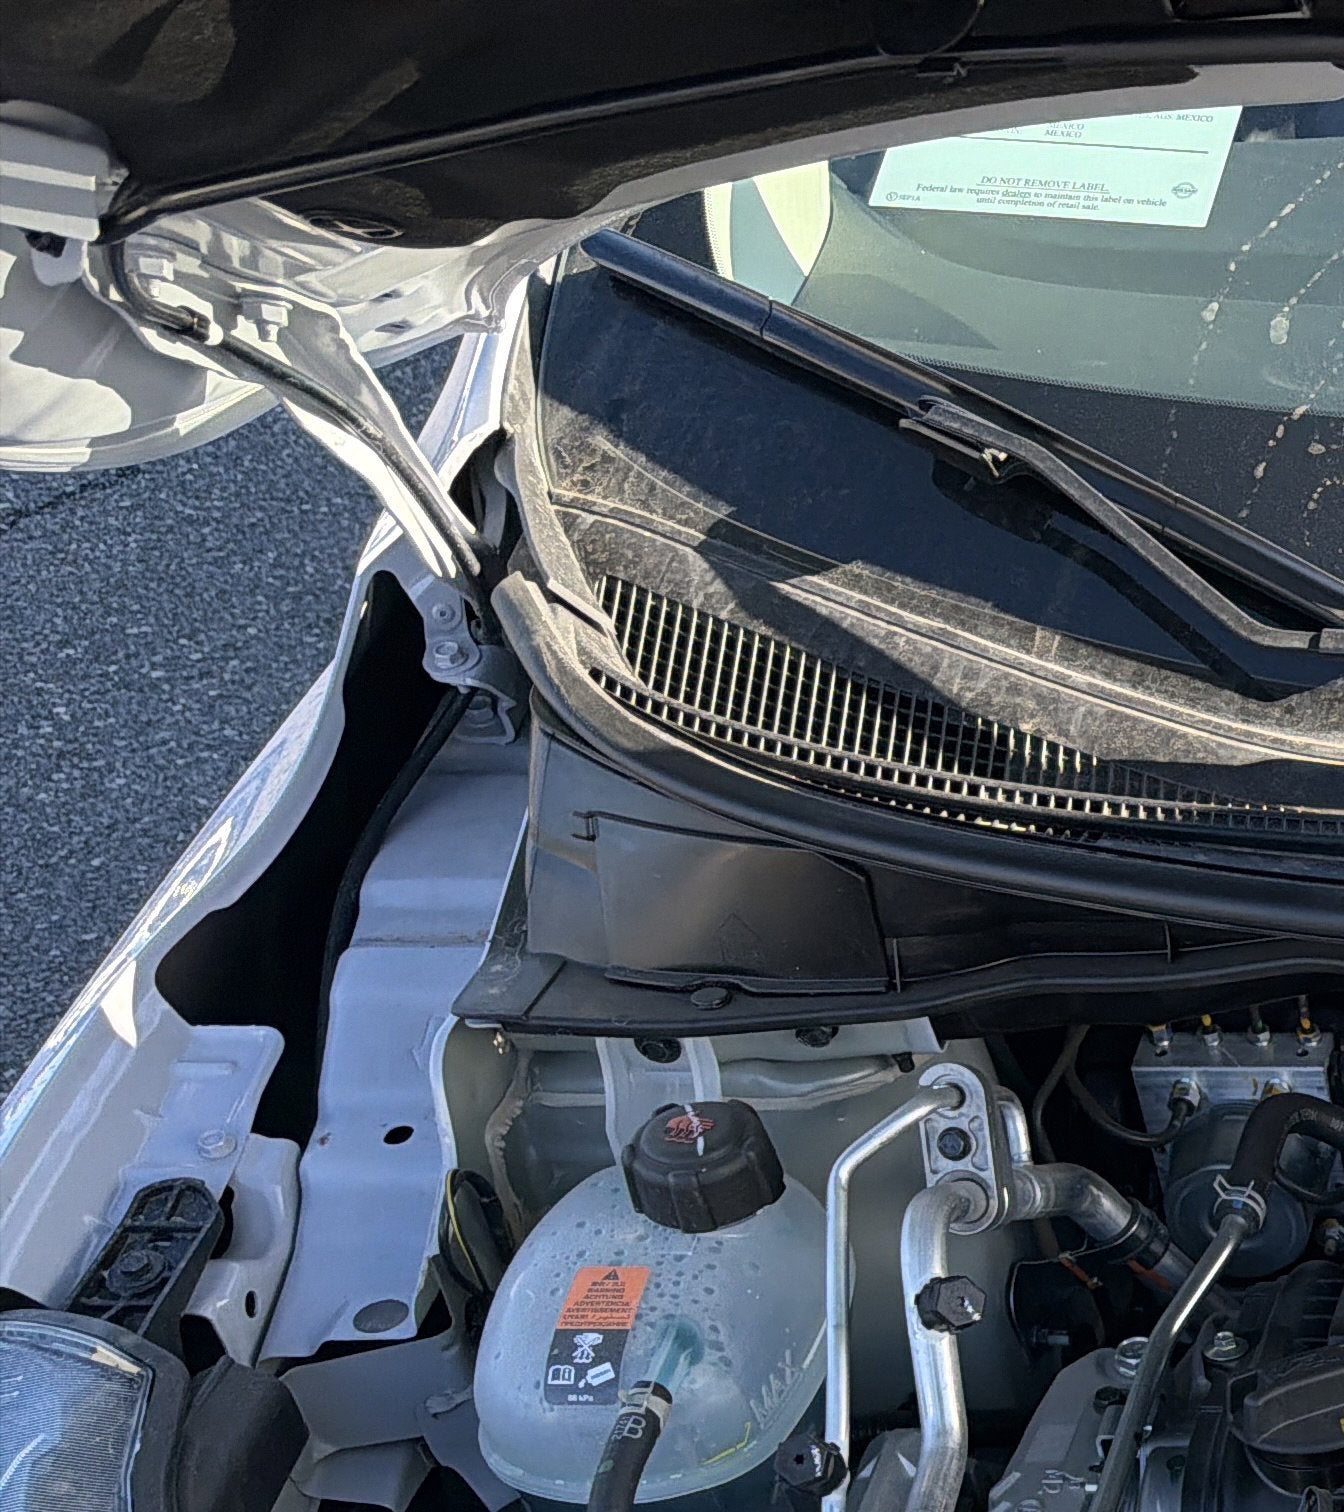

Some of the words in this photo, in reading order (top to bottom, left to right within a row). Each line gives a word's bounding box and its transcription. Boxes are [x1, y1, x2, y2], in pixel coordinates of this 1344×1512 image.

[1175, 114, 1214, 123] MEXICO
[1044, 129, 1082, 138] MEXICO
[981, 175, 996, 185] DO
[1000, 177, 1023, 187] NOT
[1023, 178, 1071, 189] REMOVE
[916, 183, 947, 193] Federal
[949, 186, 964, 194] law
[966, 188, 1000, 198] requires
[1001, 189, 1031, 199] dealers
[1044, 192, 1081, 201] maintain
[1083, 193, 1099, 202] this
[1101, 194, 1121, 203] label
[1136, 197, 1167, 207] vehicle
[976, 195, 996, 204] until
[998, 197, 1045, 207] completion
[1046, 199, 1057, 209] of
[1058, 200, 1080, 210] retail
[622, 1414, 647, 1439] B
